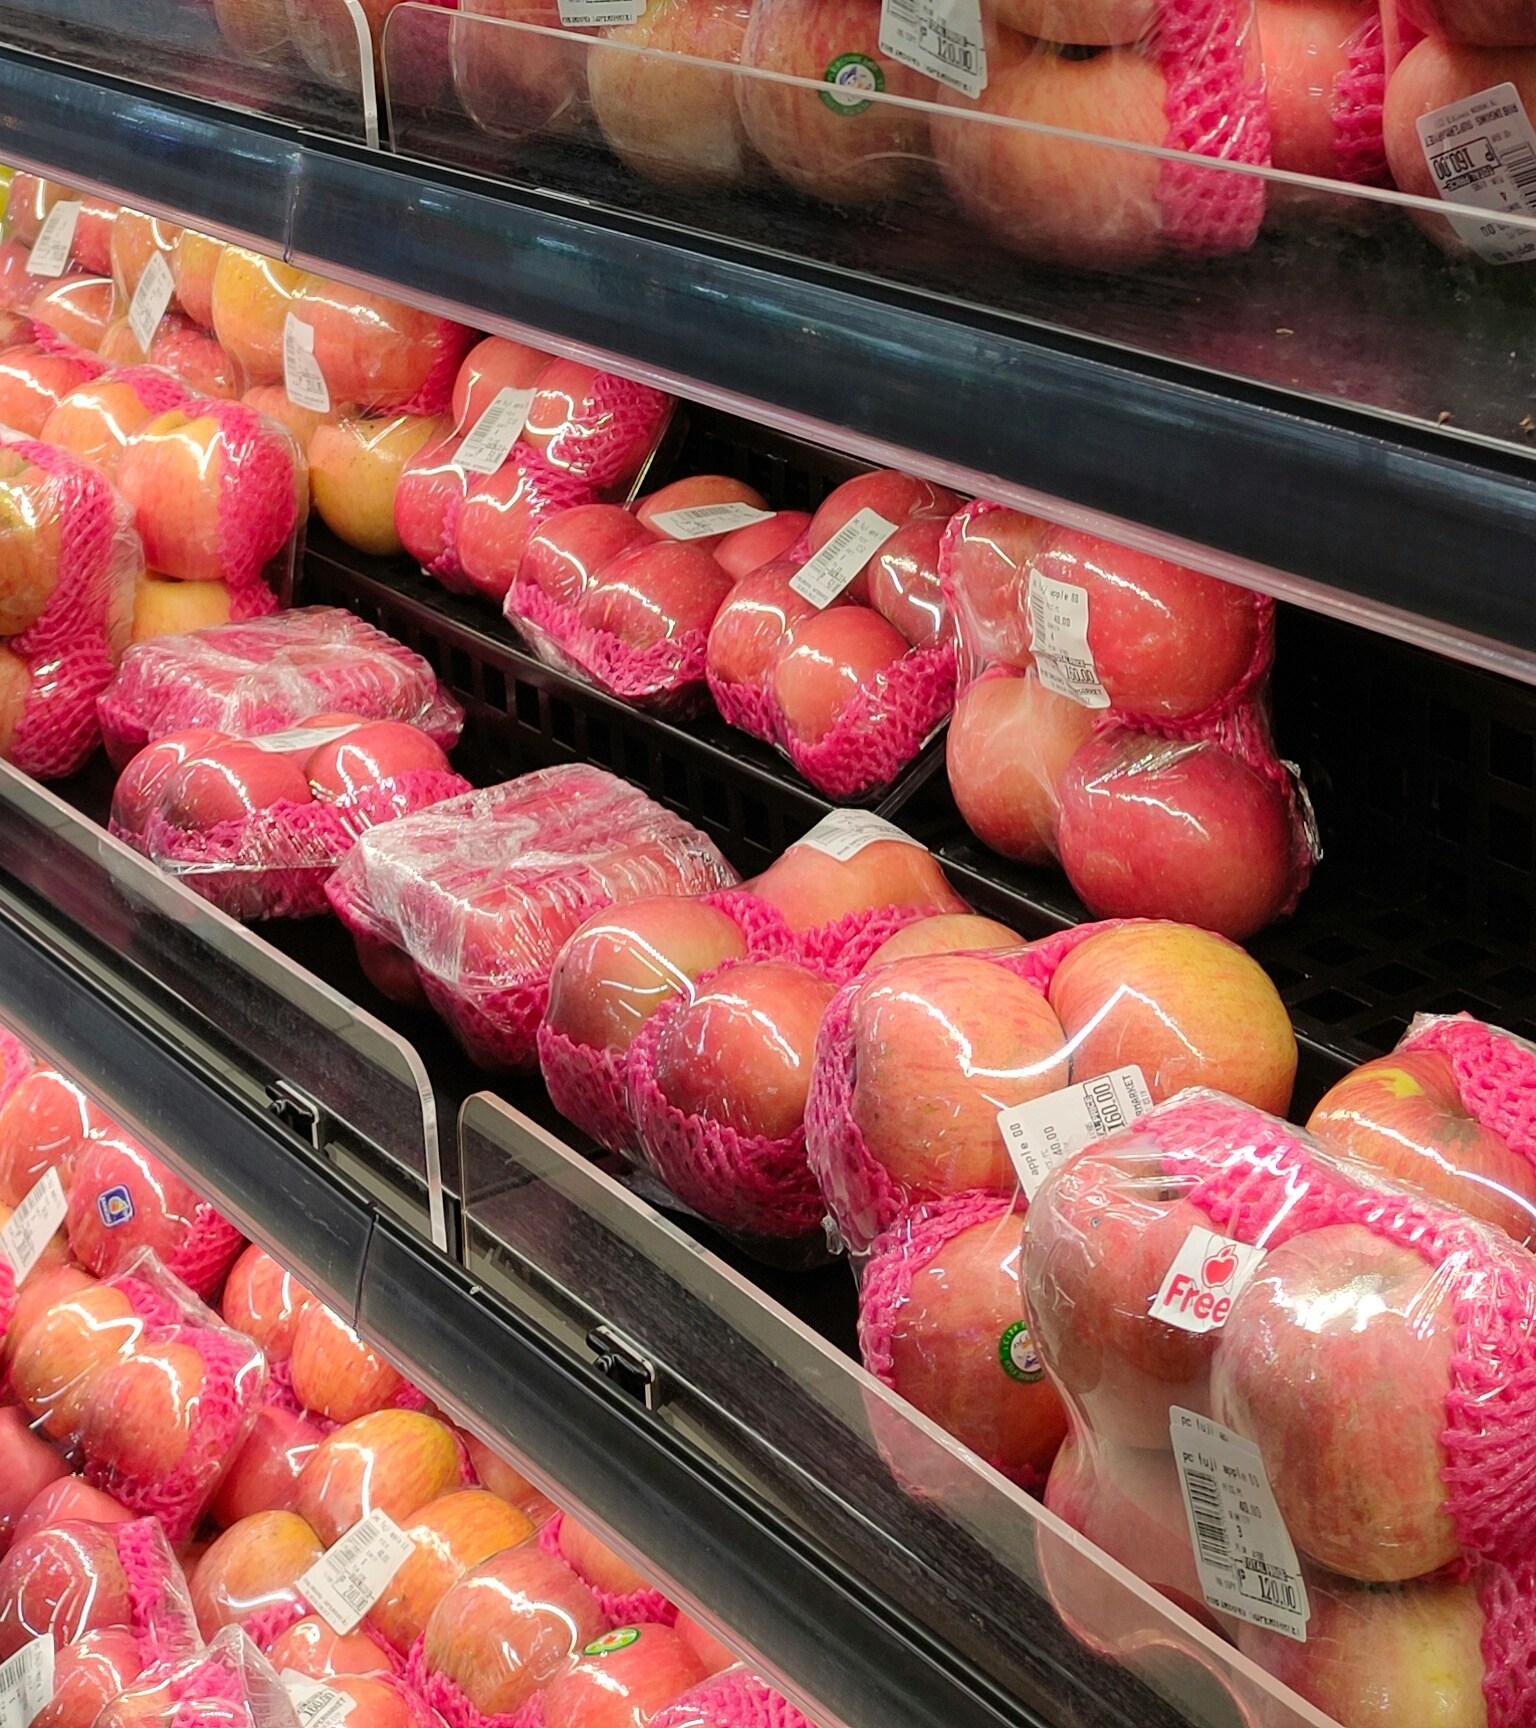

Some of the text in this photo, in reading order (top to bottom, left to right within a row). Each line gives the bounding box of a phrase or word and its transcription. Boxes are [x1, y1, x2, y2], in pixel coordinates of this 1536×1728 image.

[1092, 1082, 1126, 1132] 160.00
[1044, 1125, 1063, 1156] 40.00
[1020, 1142, 1041, 1177] apple
[1161, 1272, 1231, 1325] Free
[1182, 1452, 1194, 1465] pc
